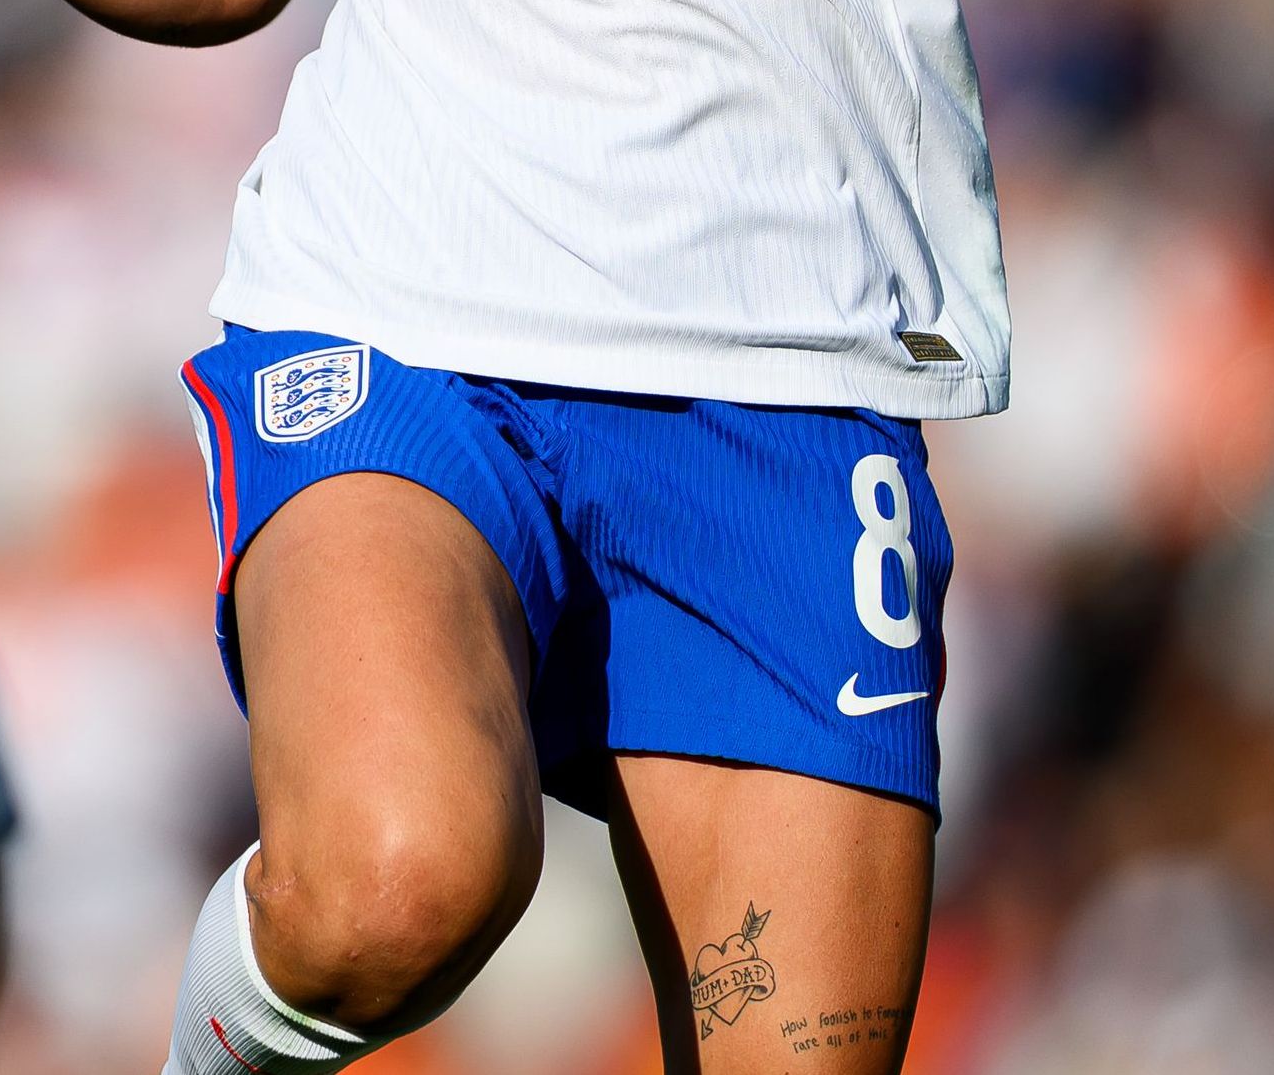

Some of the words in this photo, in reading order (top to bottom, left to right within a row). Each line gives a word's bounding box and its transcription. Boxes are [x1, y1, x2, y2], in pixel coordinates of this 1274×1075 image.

[851, 453, 922, 649] 8
[692, 978, 723, 1004] MUM
[730, 965, 767, 986] DAD
[780, 1018, 808, 1038] How
[819, 1010, 858, 1029] foolish
[793, 1037, 820, 1054] rare
[827, 1034, 842, 1048] all
[849, 1030, 862, 1044] of
